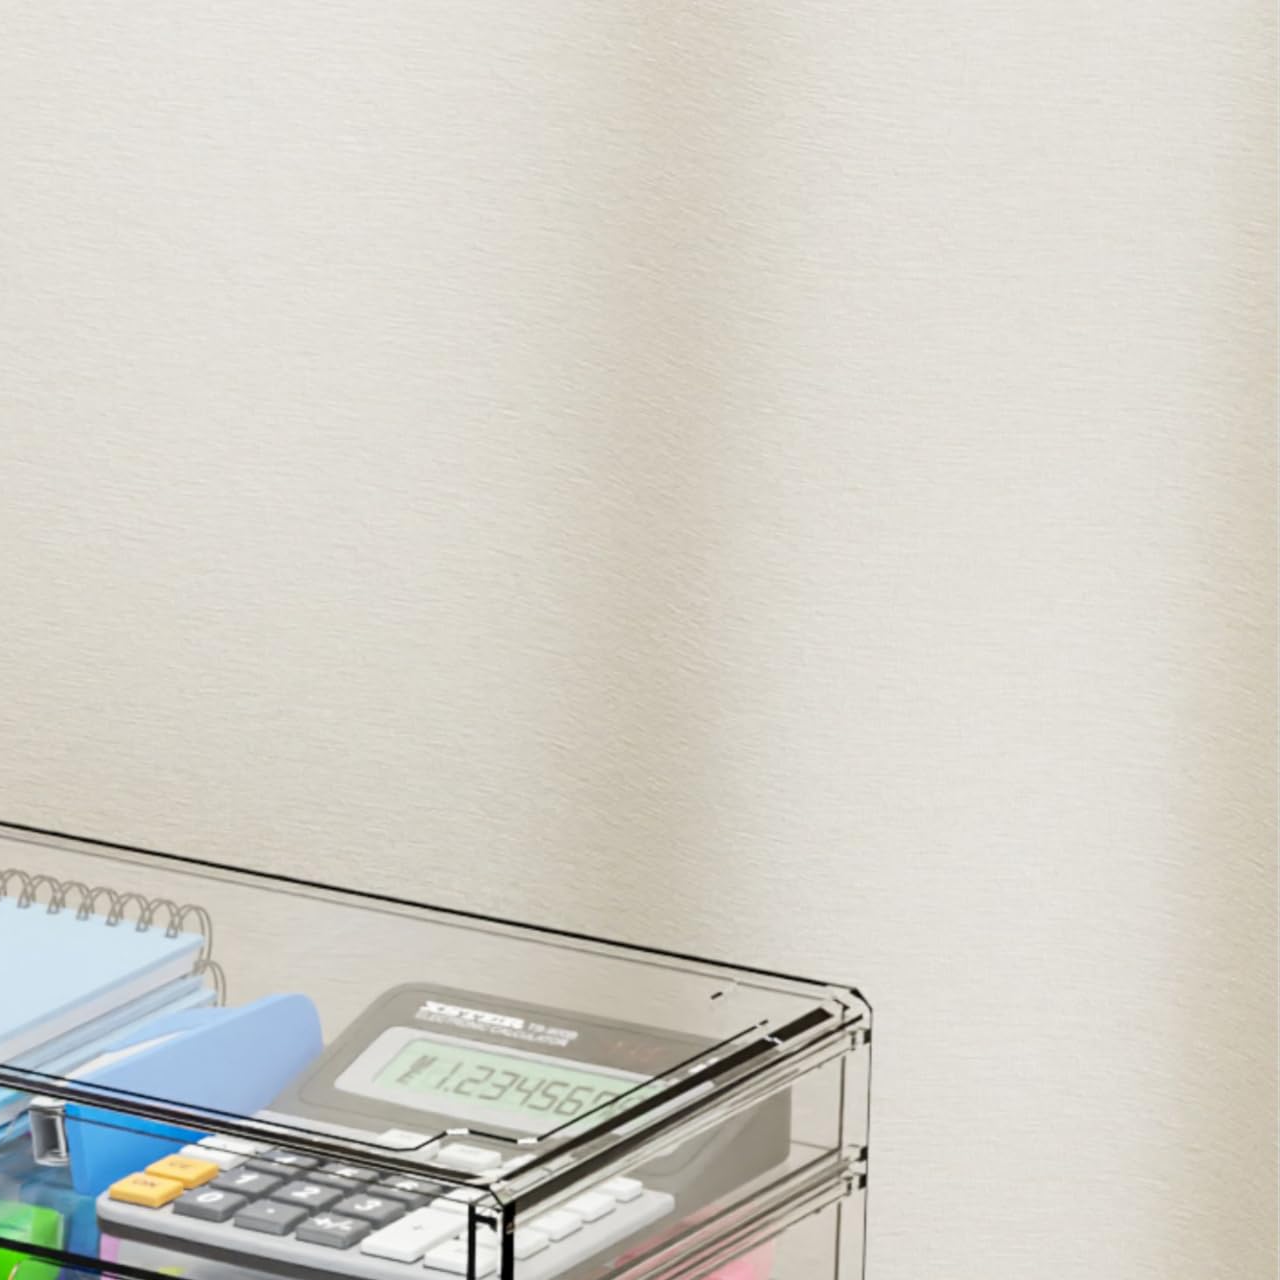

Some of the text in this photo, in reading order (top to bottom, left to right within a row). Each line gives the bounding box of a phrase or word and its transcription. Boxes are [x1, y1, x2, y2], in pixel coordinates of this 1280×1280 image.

[197, 1191, 225, 1203] 0
[291, 1186, 320, 1198] 2
[354, 1200, 382, 1212] 3
